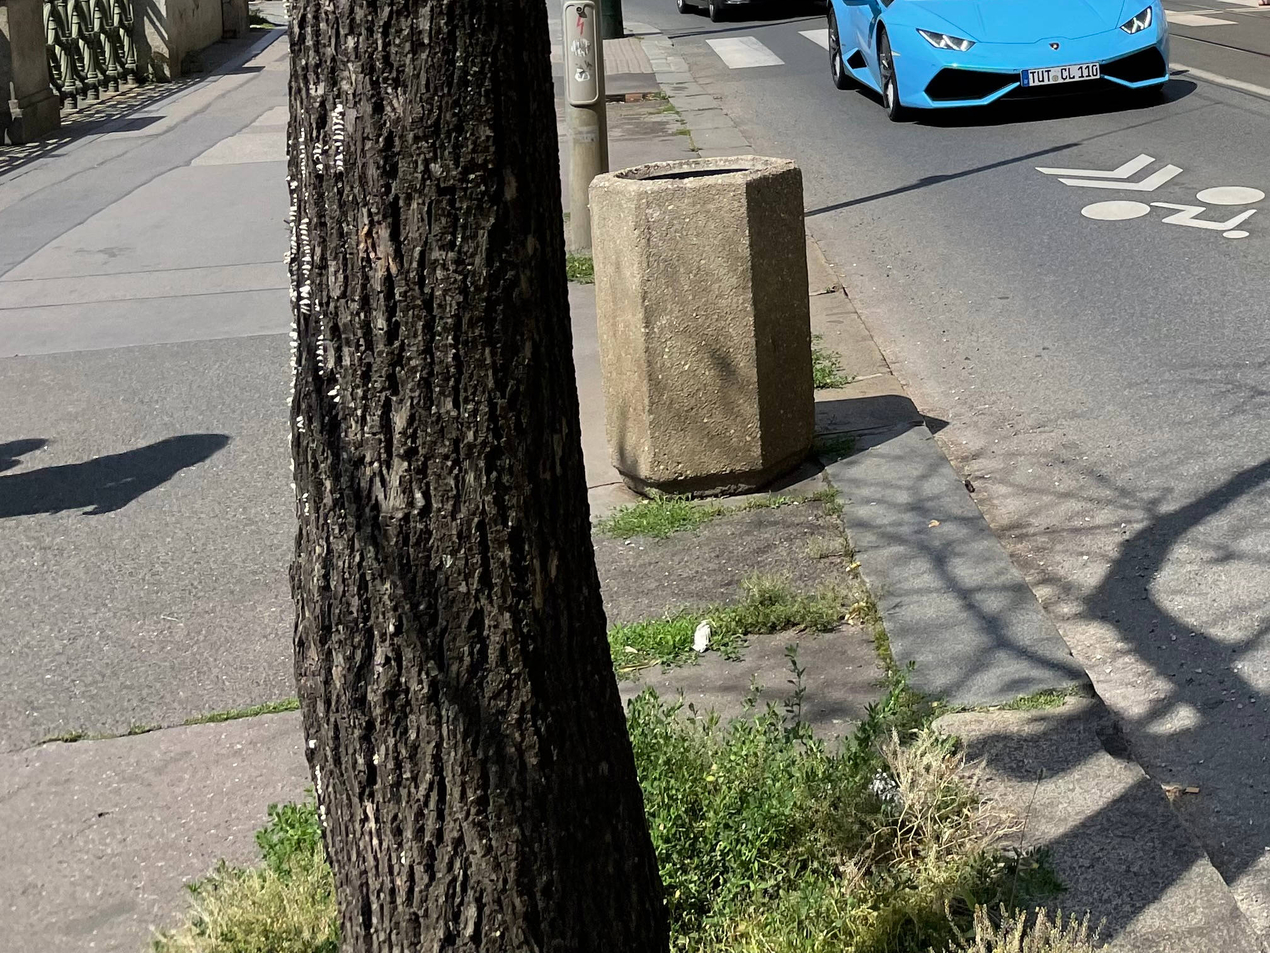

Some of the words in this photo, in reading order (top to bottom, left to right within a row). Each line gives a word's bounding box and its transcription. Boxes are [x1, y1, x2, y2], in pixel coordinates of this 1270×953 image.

[1030, 69, 1052, 84] TUT
[1060, 67, 1075, 81] CL
[1077, 64, 1099, 79] 110
